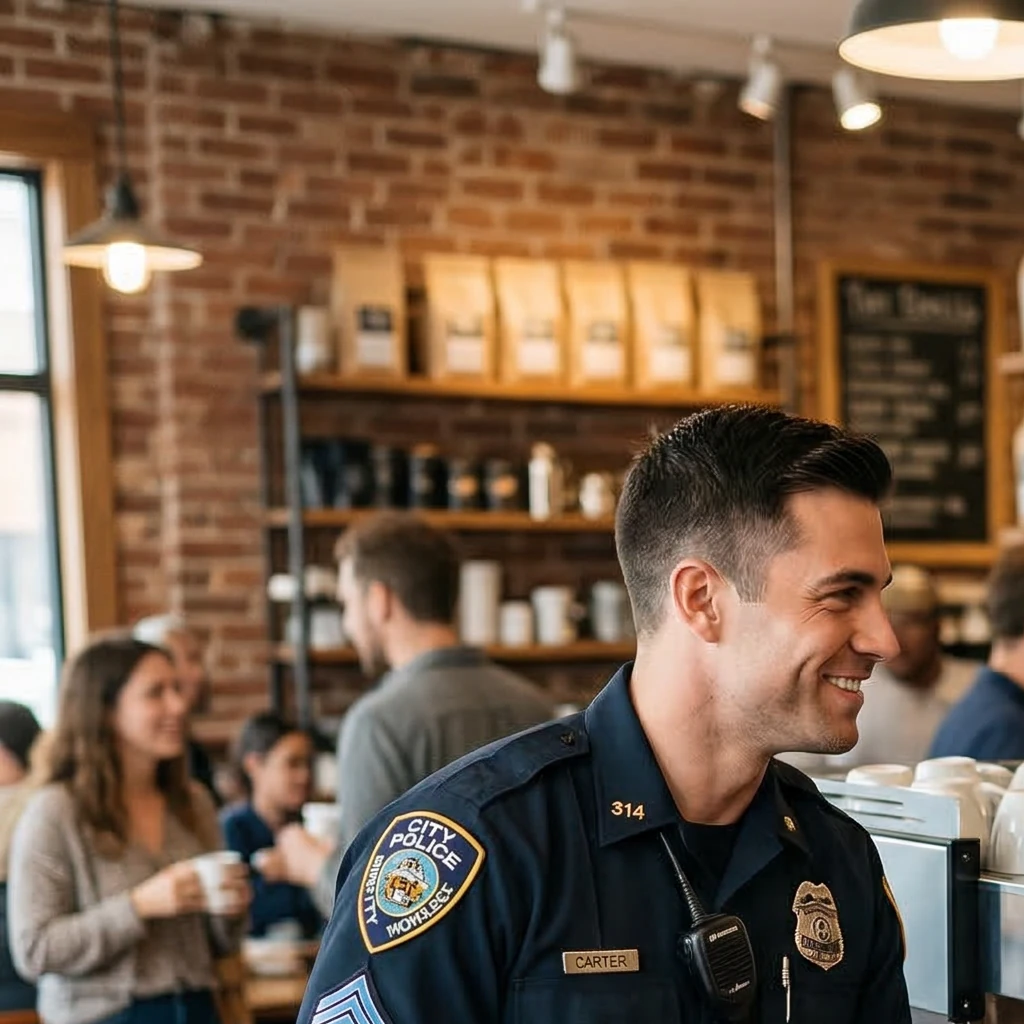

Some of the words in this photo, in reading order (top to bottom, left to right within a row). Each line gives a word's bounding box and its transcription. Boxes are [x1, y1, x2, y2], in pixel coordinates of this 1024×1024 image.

[611, 801, 645, 820] 314
[408, 819, 457, 843] CITY
[389, 833, 462, 871] POLICE
[574, 955, 628, 970] CARTER
